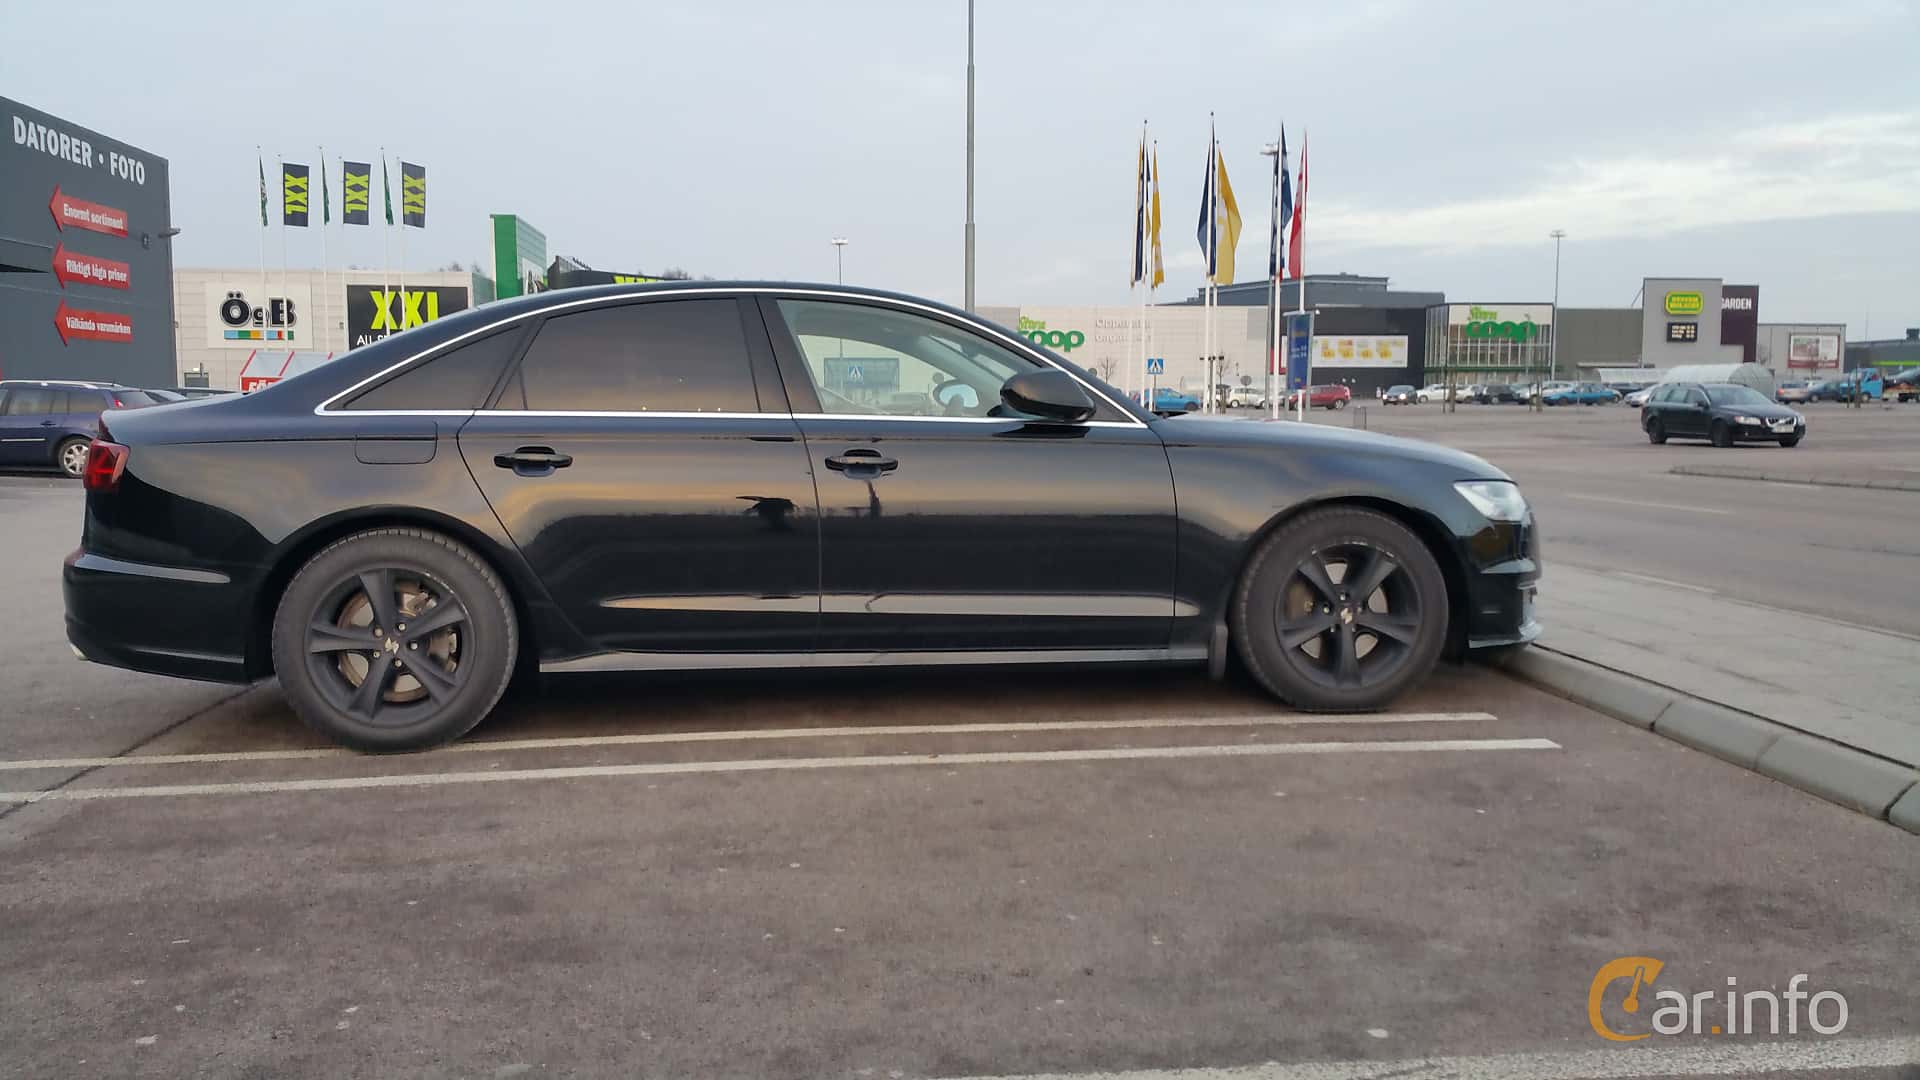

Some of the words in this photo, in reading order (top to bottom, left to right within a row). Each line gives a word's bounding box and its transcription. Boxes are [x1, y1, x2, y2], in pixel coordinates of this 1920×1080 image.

[13, 115, 93, 168] DATORER
[109, 151, 146, 185] FOTO
[63, 202, 90, 222] Enormt
[285, 172, 308, 216] XXL
[345, 172, 369, 214] XXL
[403, 173, 425, 216] XXL
[1466, 321, 1536, 343] coop
